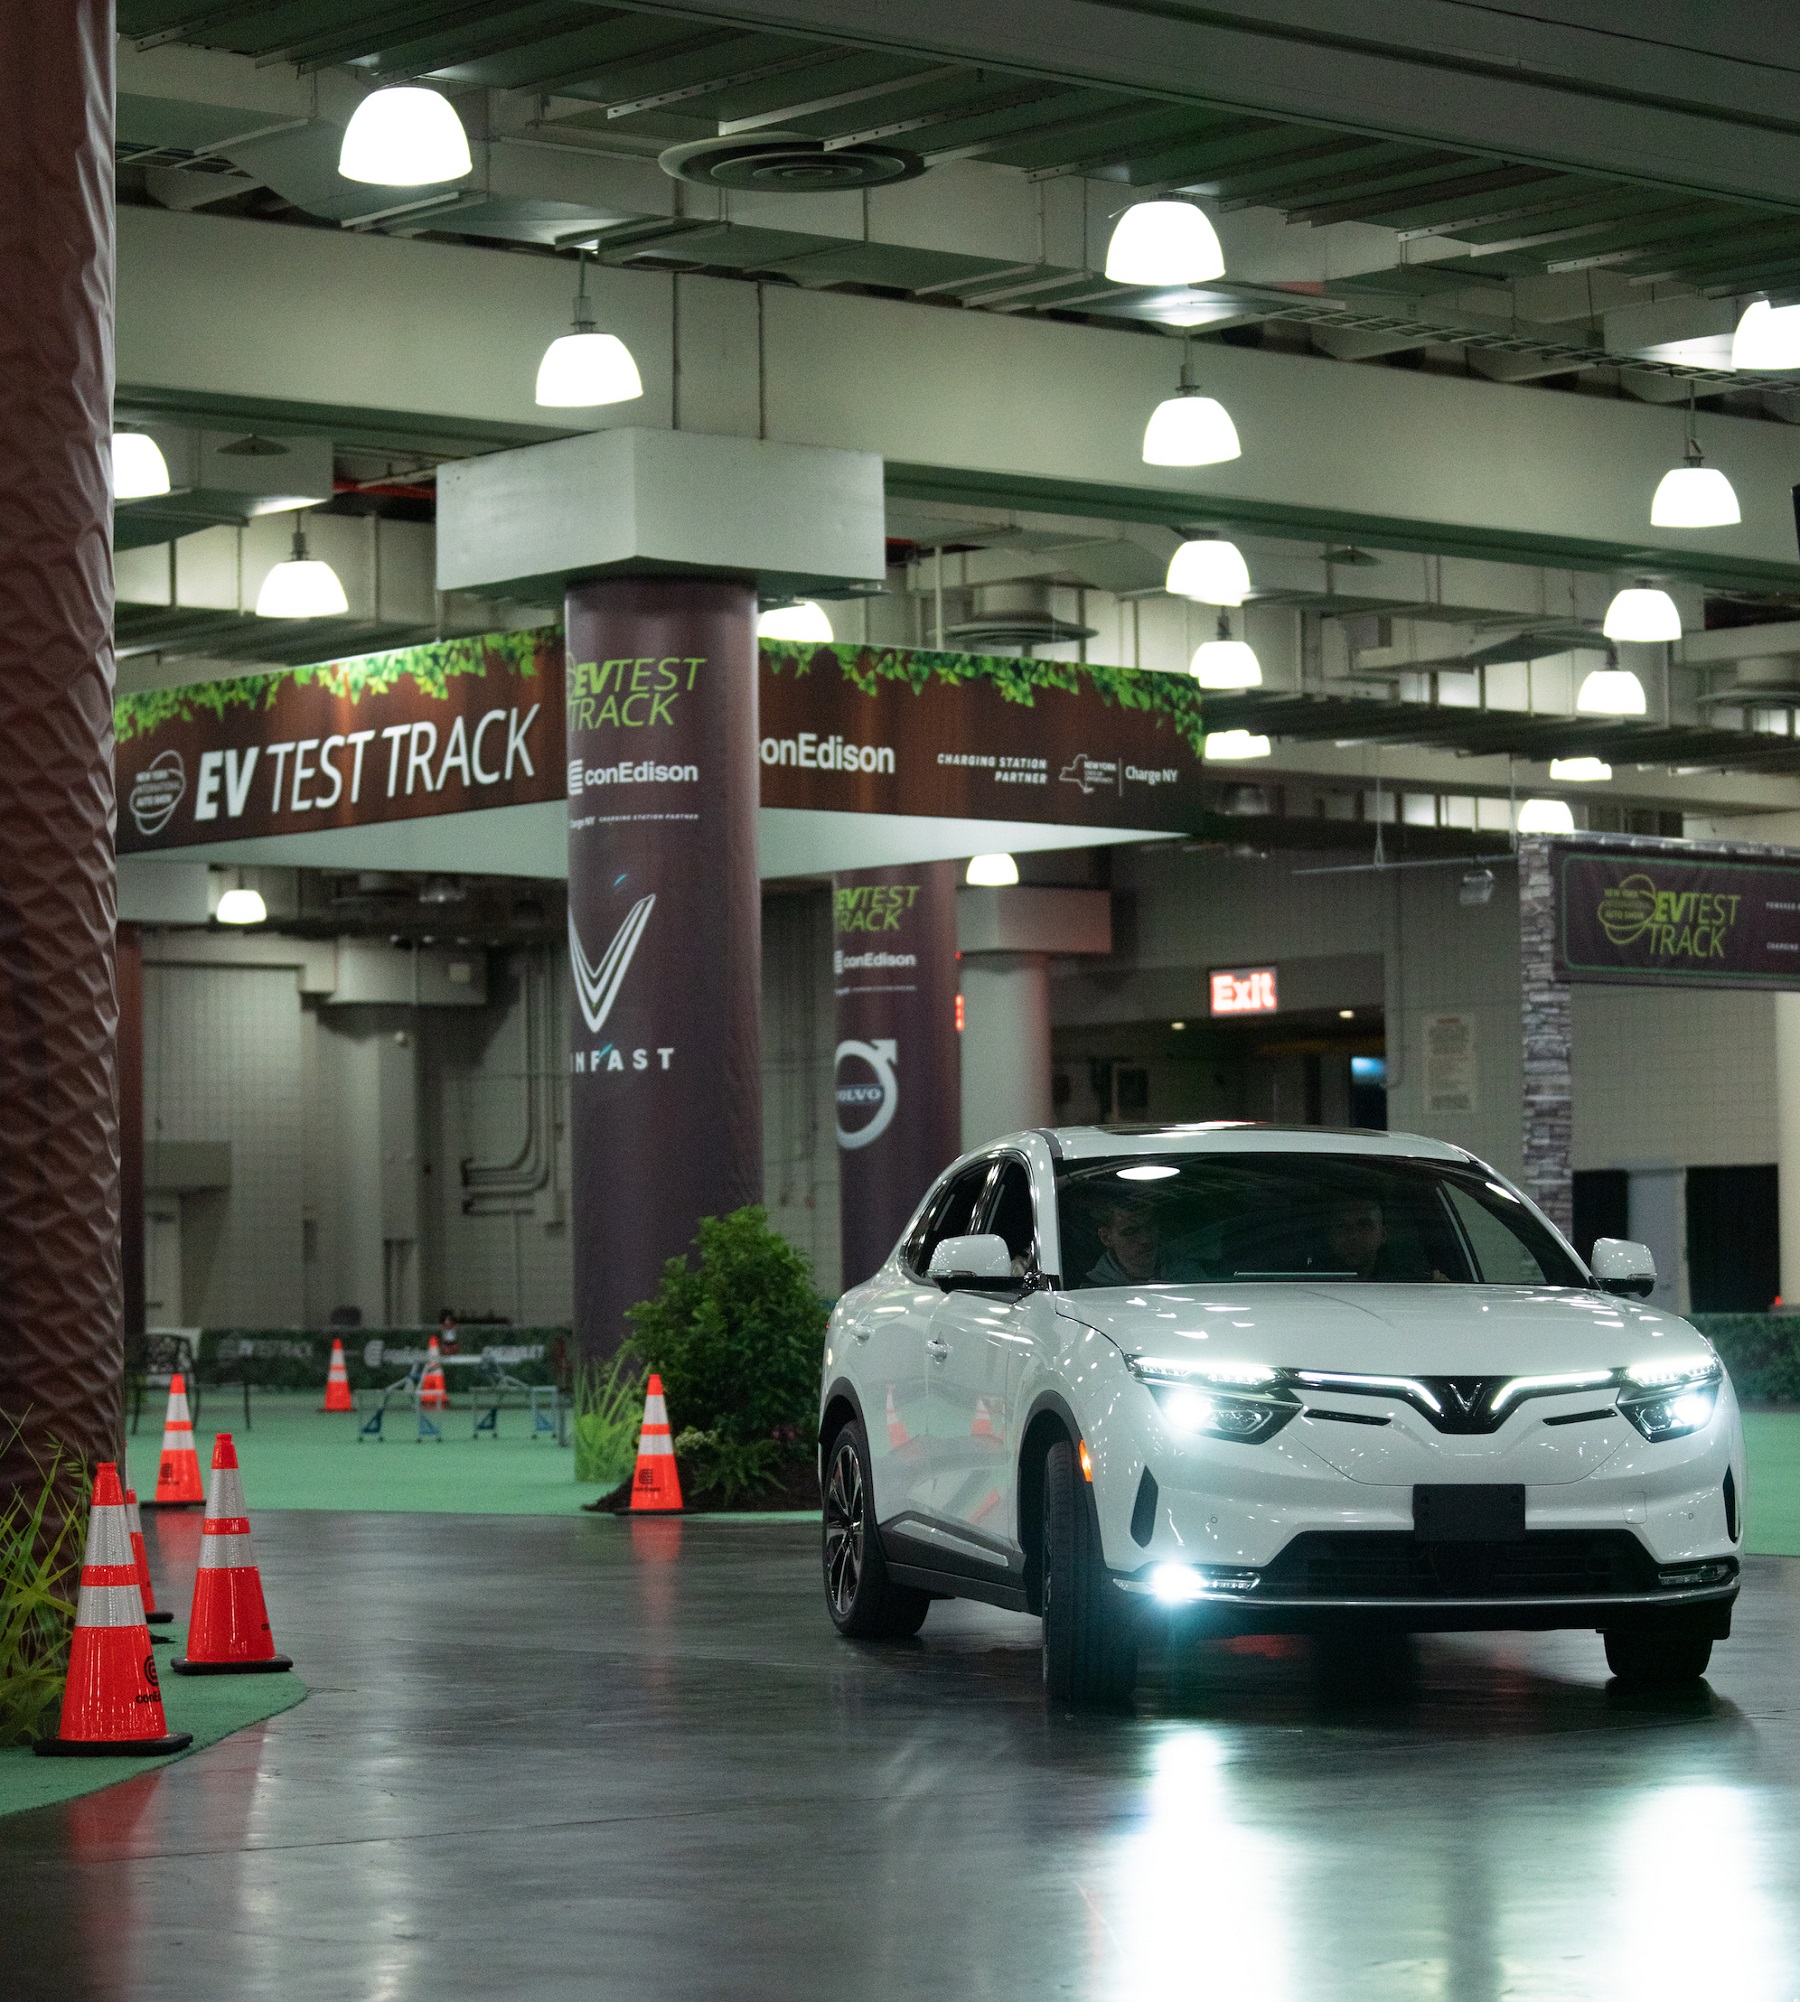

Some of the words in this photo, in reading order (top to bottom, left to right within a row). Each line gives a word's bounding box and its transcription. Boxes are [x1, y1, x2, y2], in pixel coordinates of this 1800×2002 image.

[569, 692, 680, 731] TRACK
[195, 746, 260, 821] EV
[266, 729, 375, 814] TEST
[381, 703, 541, 799] TRACK
[760, 732, 896, 774] onEdison
[936, 753, 996, 768] CHARGING
[999, 756, 1048, 770] STATION
[584, 760, 699, 787] conEdison
[994, 771, 1048, 784] PARTNER
[1125, 765, 1161, 786] Charge
[1162, 768, 1178, 783] NY
[1648, 923, 1727, 958] TRACK
[1211, 971, 1277, 1013] Exit
[836, 1087, 881, 1102] OLVO
